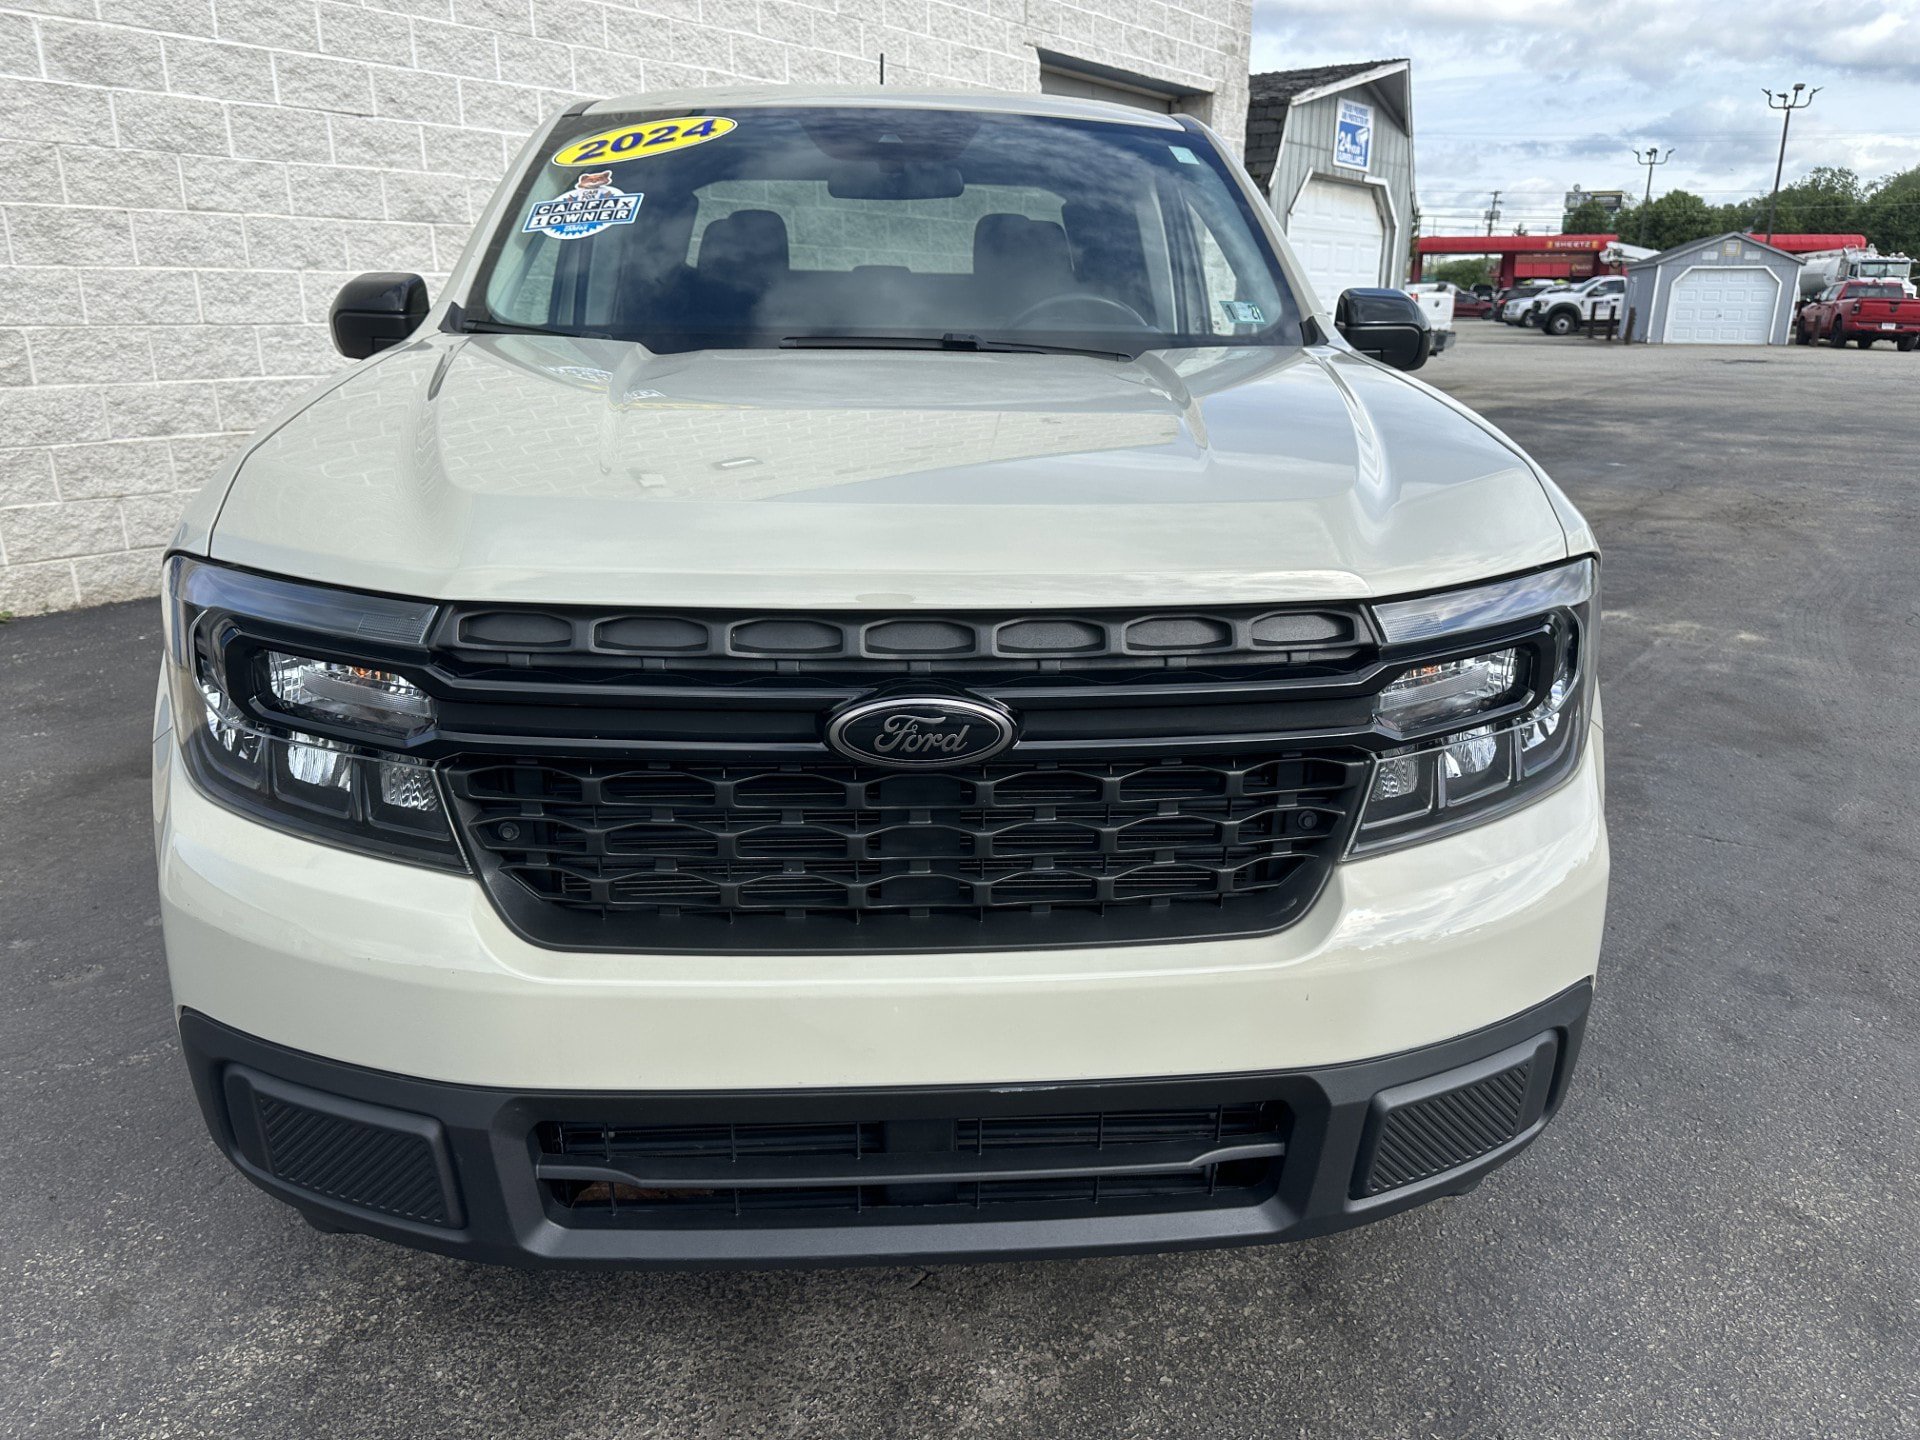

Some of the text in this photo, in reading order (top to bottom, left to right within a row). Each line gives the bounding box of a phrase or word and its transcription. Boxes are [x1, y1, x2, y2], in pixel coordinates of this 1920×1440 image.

[572, 119, 717, 163] 2024
[538, 200, 633, 214] CARFAX
[549, 210, 629, 224] OWNER
[874, 714, 970, 752] Ford
